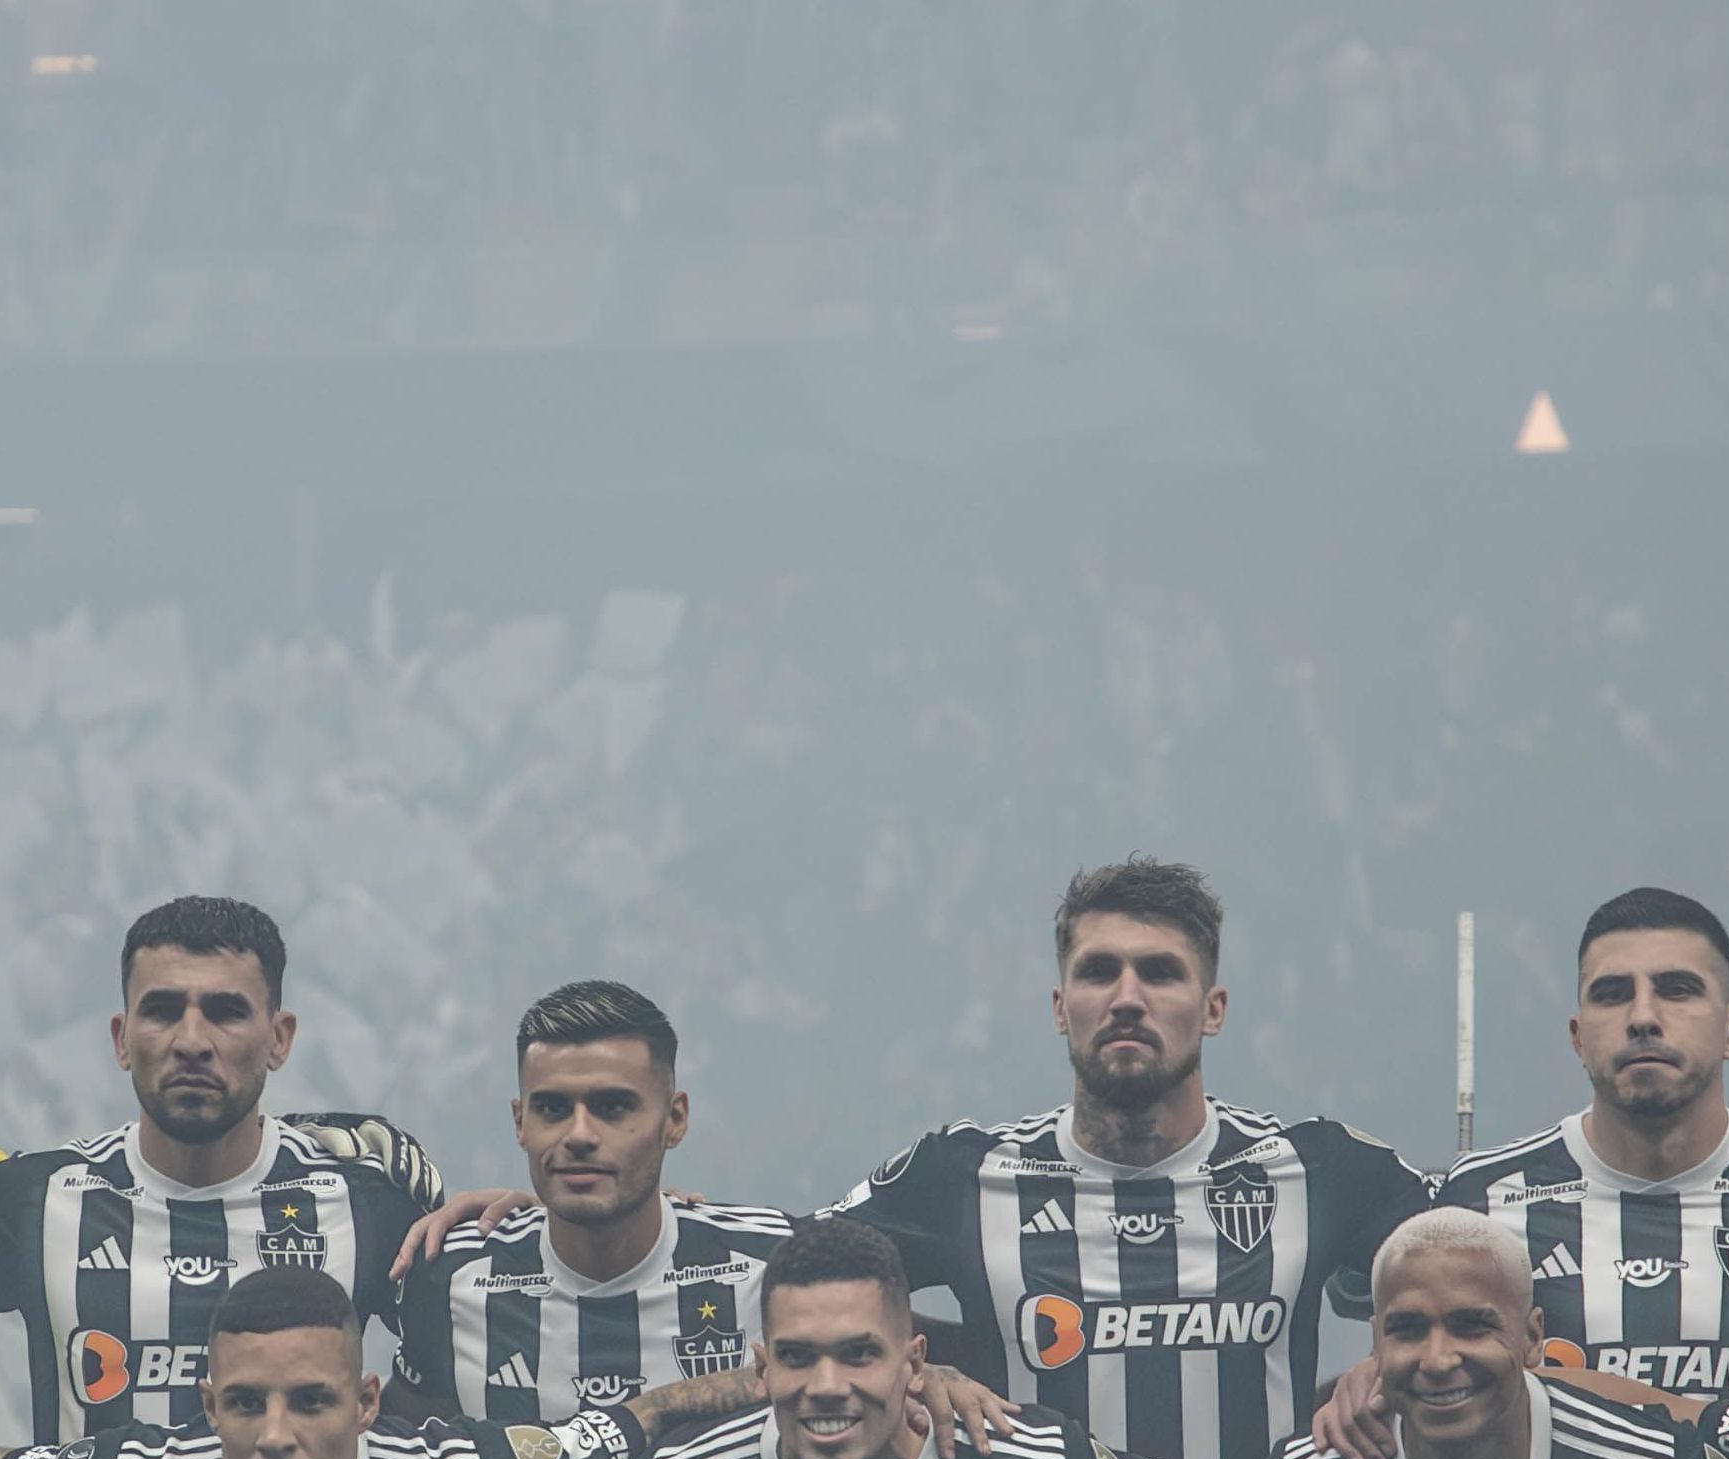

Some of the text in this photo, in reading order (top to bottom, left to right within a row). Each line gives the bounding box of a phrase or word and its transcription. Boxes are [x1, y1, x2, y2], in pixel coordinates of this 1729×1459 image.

[1215, 1189, 1267, 1203] CAM
[1503, 1180, 1589, 1204] Multimarcas
[1109, 1213, 1157, 1235] YOU
[267, 1238, 317, 1251] CAM
[165, 1256, 212, 1276] YOU
[663, 1260, 750, 1284] Multimarcas
[1615, 1258, 1662, 1279] YOU
[473, 1274, 554, 1289] Multimarcas
[1093, 1300, 1283, 1349] BETANO
[685, 1338, 736, 1355] CAM
[573, 1375, 620, 1398] YOU
